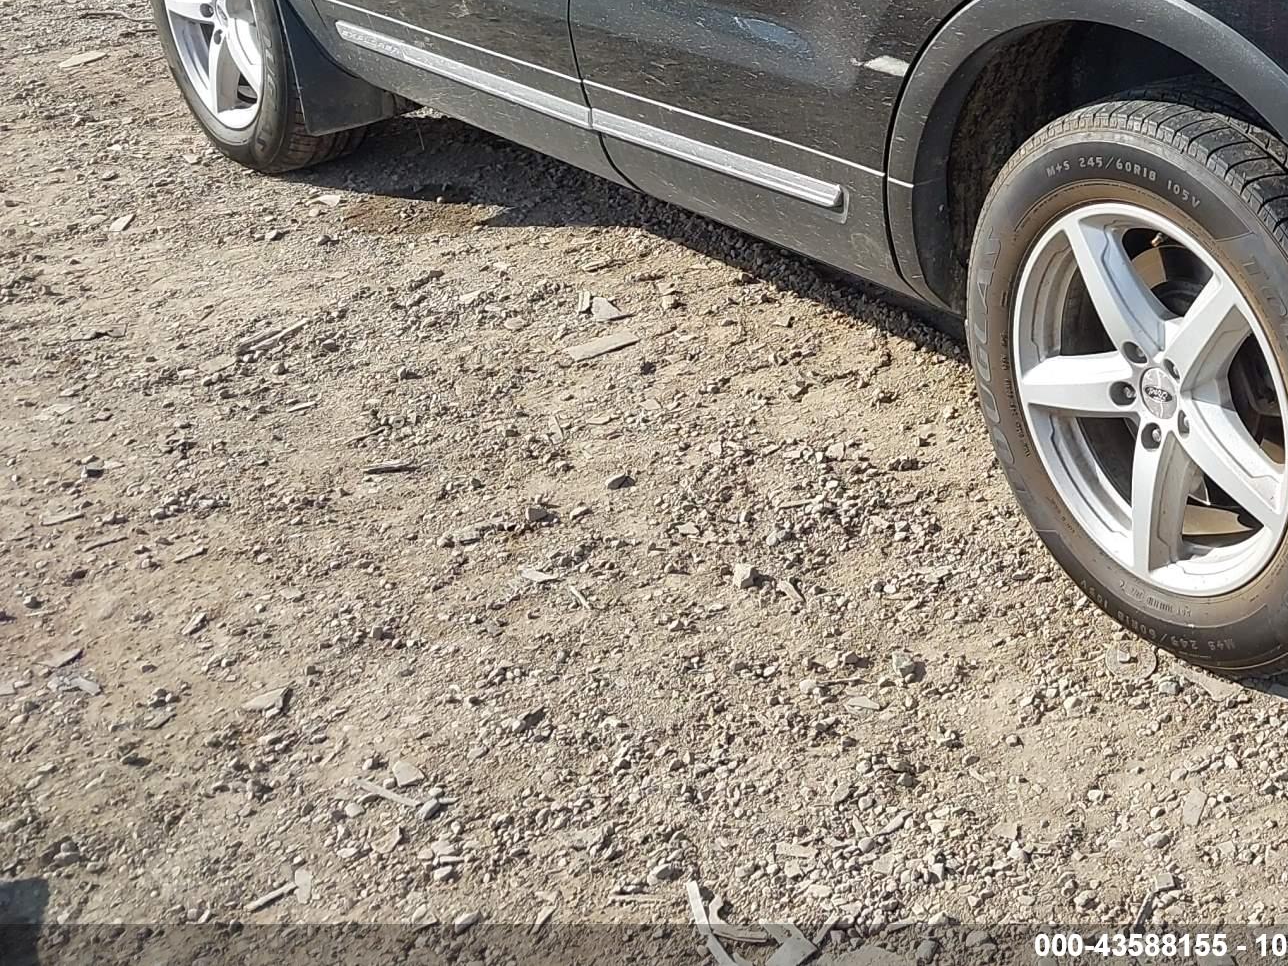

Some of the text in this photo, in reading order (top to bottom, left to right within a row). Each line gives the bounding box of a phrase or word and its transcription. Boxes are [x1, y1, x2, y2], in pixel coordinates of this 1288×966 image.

[1046, 156, 1201, 208] M+S 245/60R18 105V
